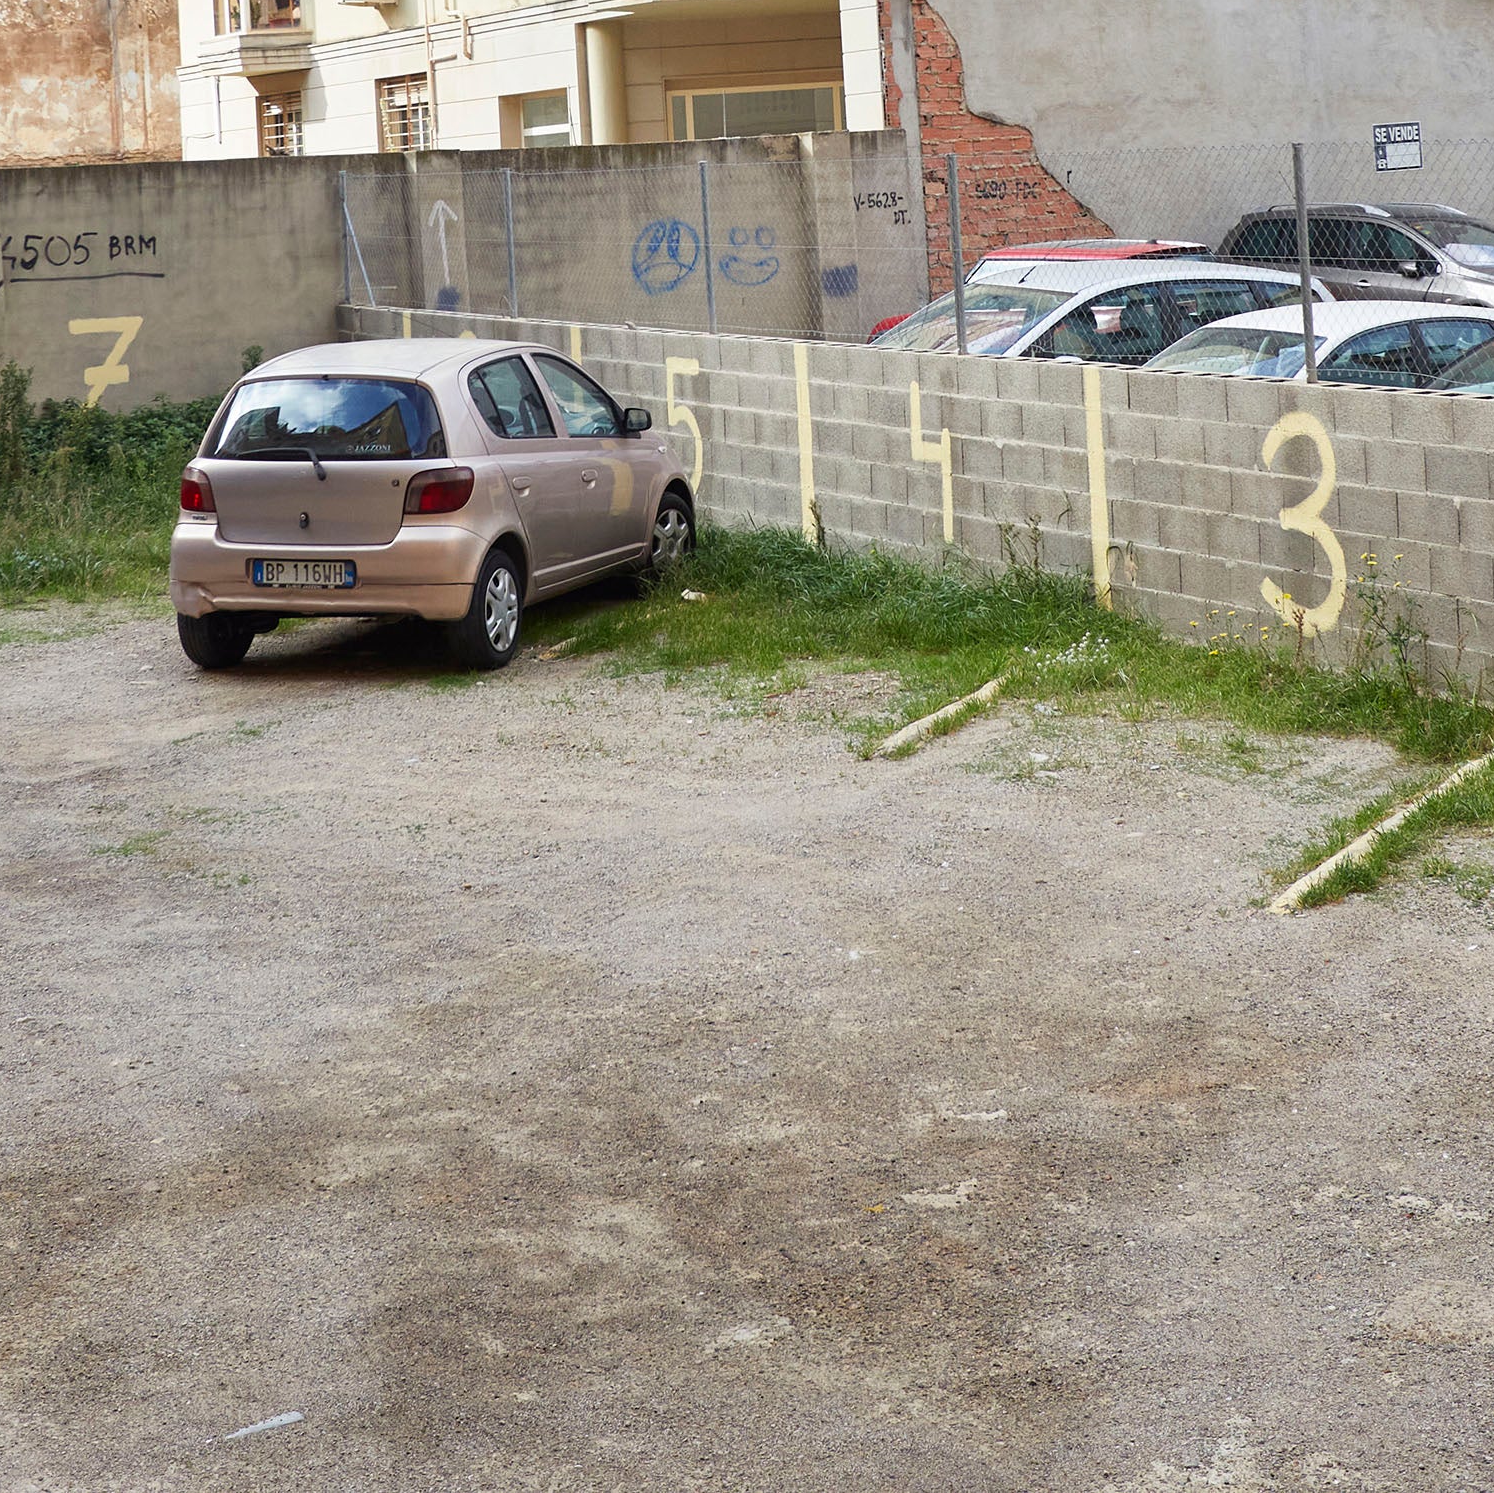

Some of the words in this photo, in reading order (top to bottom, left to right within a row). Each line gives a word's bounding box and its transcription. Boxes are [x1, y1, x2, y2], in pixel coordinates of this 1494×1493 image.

[1375, 127, 1387, 143] SE
[1388, 125, 1419, 142] VENDE
[108, 235, 157, 260] BRM
[68, 315, 144, 409] 7
[354, 444, 391, 452] JAZZONI
[665, 356, 703, 496] 5
[910, 381, 954, 543] 4
[1260, 411, 1347, 638] 3
[265, 562, 285, 582] BP
[293, 563, 344, 583] 116WH
